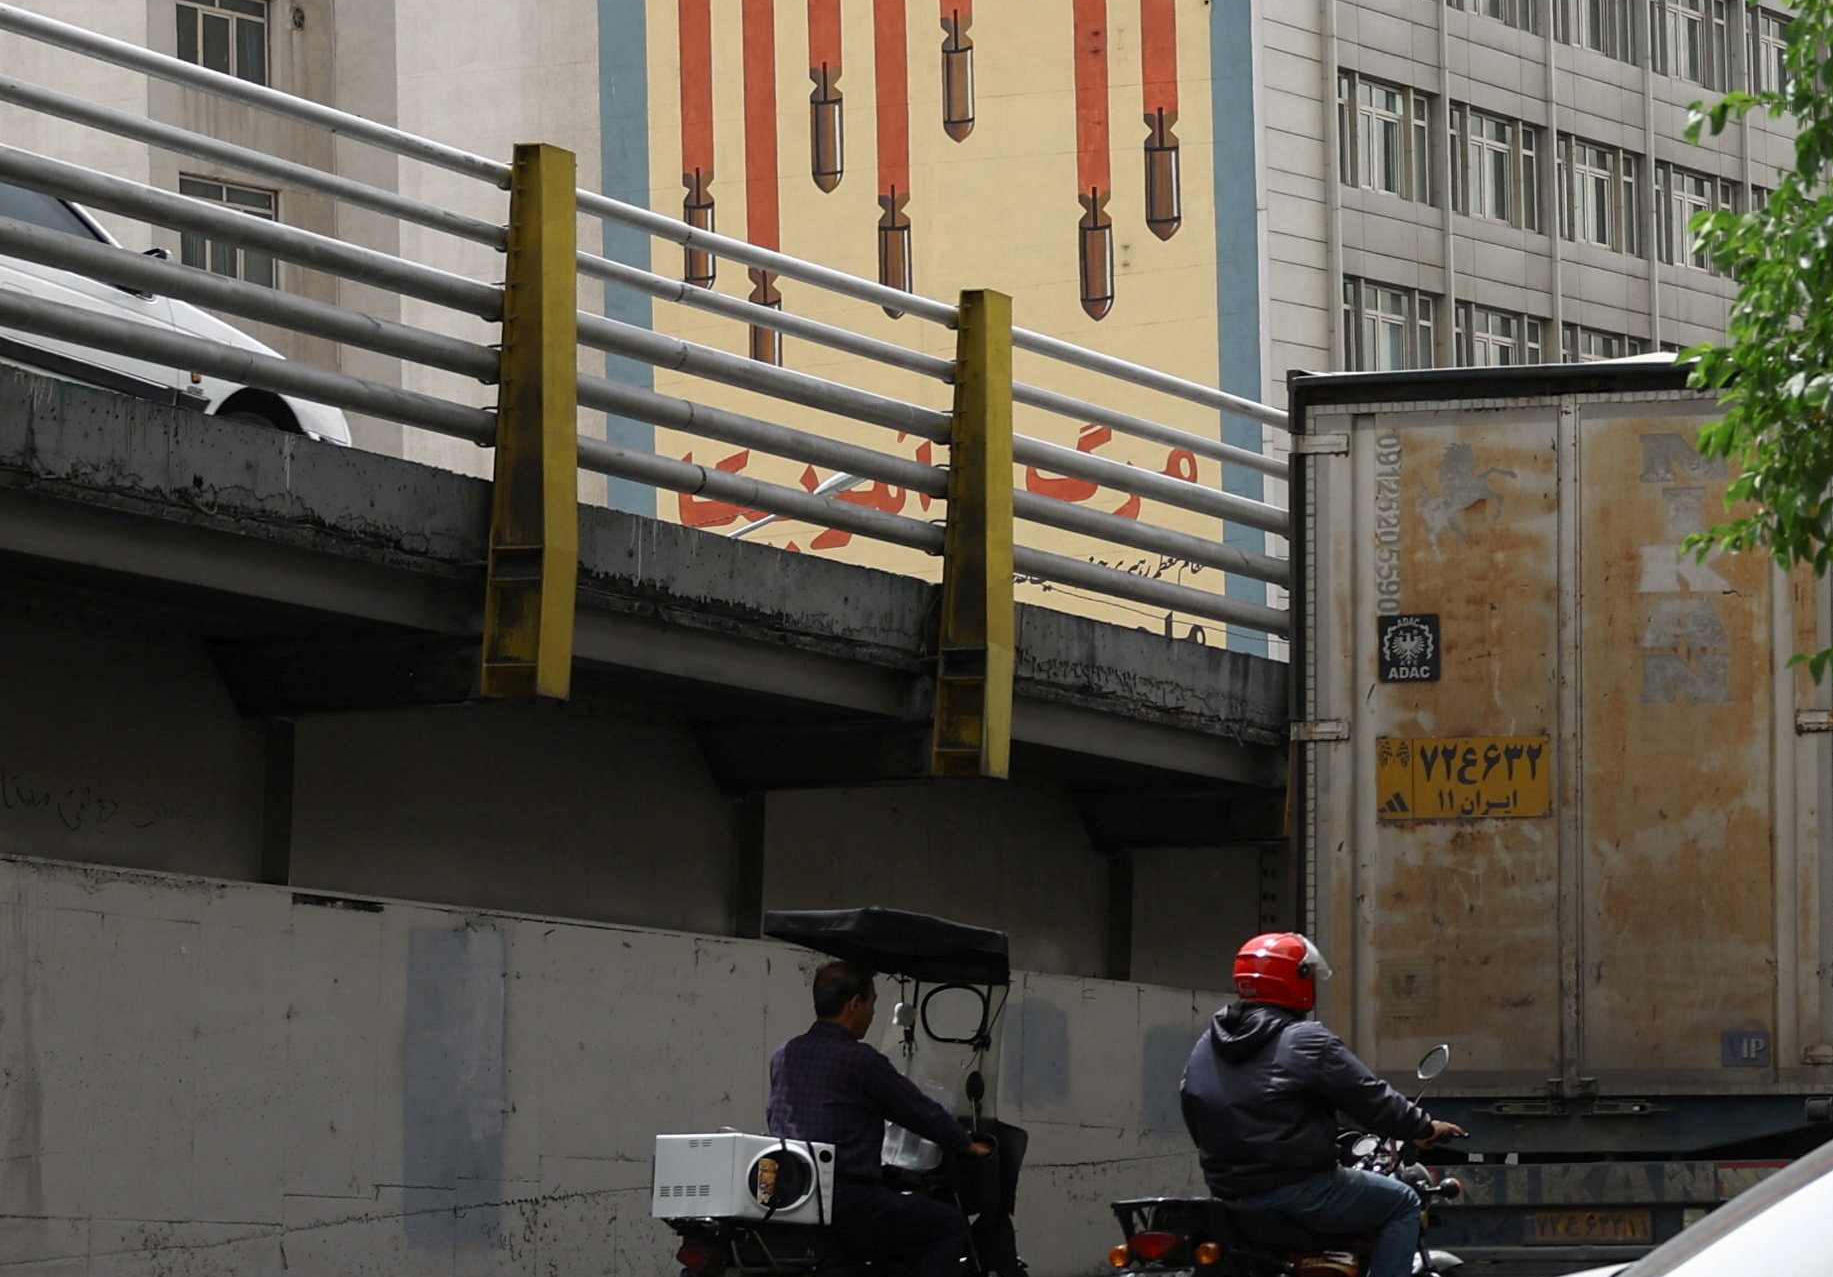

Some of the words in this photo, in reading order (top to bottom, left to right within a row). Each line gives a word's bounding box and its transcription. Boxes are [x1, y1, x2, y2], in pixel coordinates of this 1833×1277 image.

[1376, 434, 1401, 614] 09125205590
[1637, 432, 1733, 704] NIKAN
[1388, 666, 1430, 680] ADAC
[1439, 790, 1454, 811] ۱۱
[1460, 790, 1518, 815] ایران
